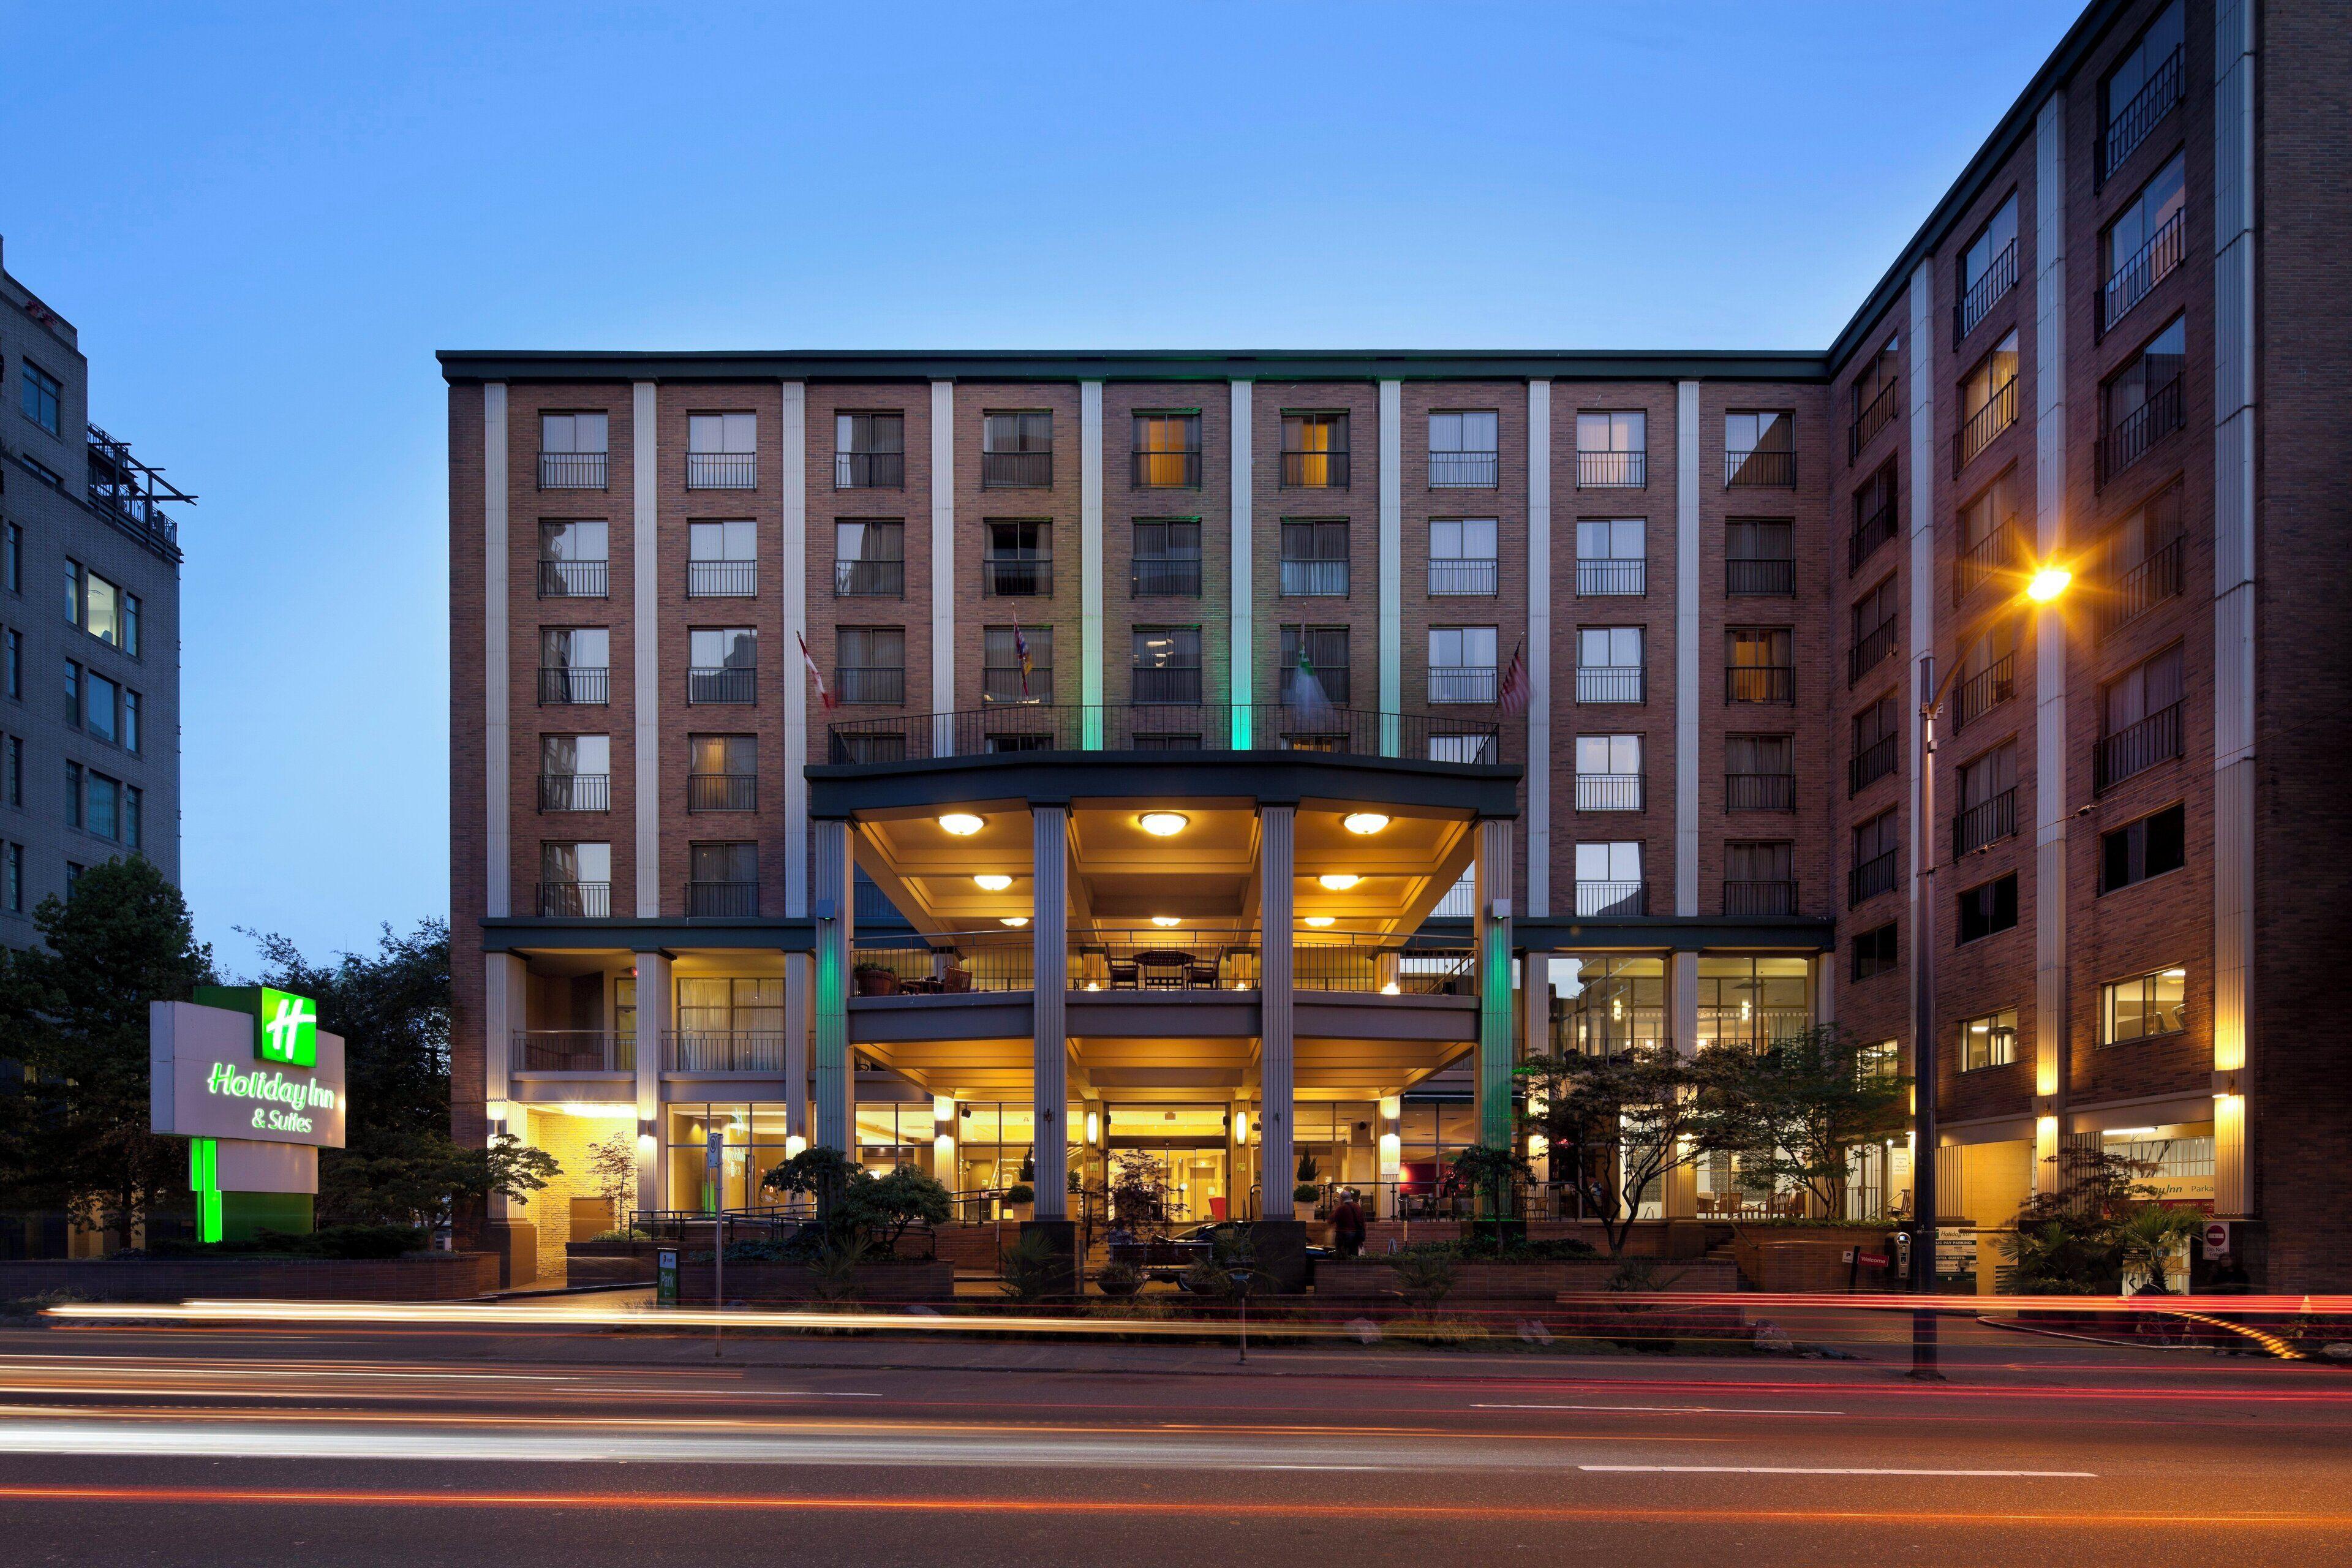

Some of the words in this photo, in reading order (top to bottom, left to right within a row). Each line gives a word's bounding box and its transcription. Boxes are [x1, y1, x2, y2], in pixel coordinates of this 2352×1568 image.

[208, 1063, 307, 1110] Holiday
[308, 1077, 335, 1109] Inn
[252, 1108, 266, 1128] &
[268, 1109, 312, 1133] Suites
[2166, 1185, 2182, 1193] Inn
[662, 1272, 674, 1287] Park
